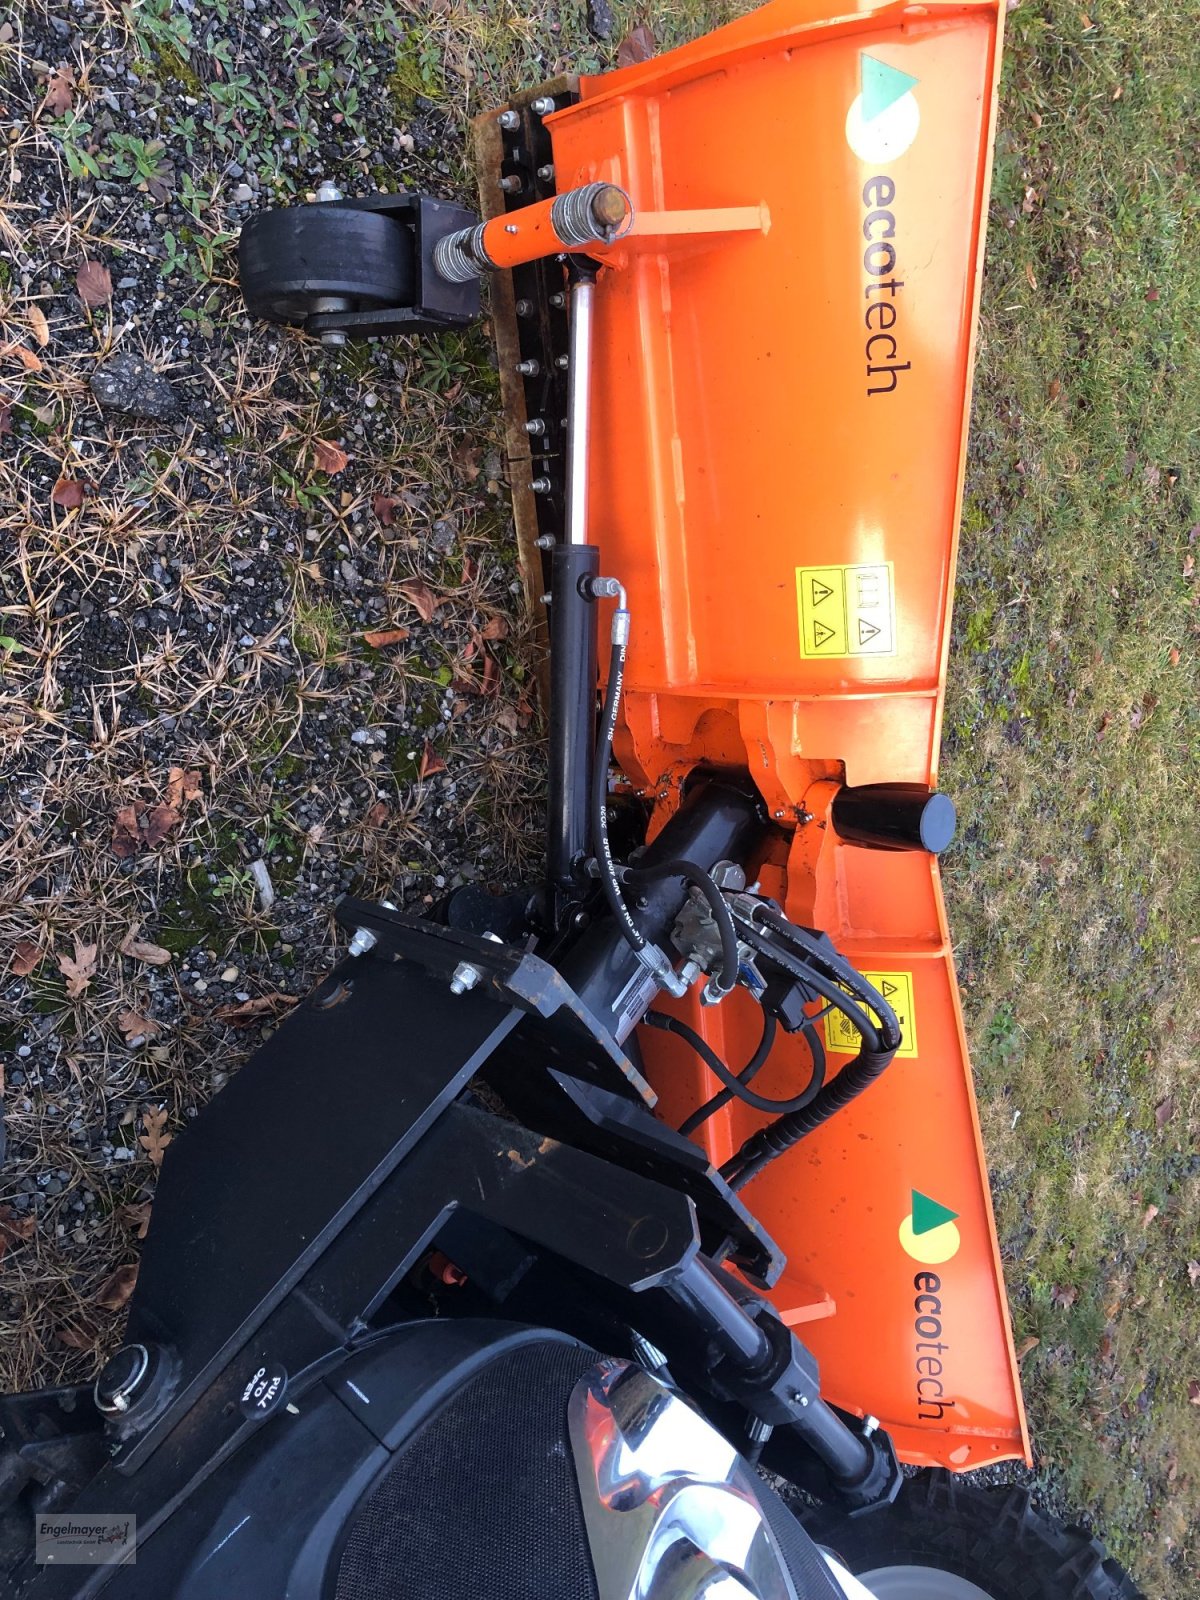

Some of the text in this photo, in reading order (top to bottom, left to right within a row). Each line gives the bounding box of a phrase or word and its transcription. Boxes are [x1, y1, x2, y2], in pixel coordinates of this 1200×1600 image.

[863, 175, 911, 397] ecotech
[611, 671, 623, 720] GERMANY
[619, 645, 627, 662] DIN
[603, 837, 611, 858] BAR
[612, 878, 621, 896] WP
[623, 911, 634, 927] DN
[913, 1271, 956, 1420] ecotech
[242, 1367, 266, 1401] OPEN
[254, 1380, 268, 1397] TO
[257, 1376, 281, 1408] PULL
